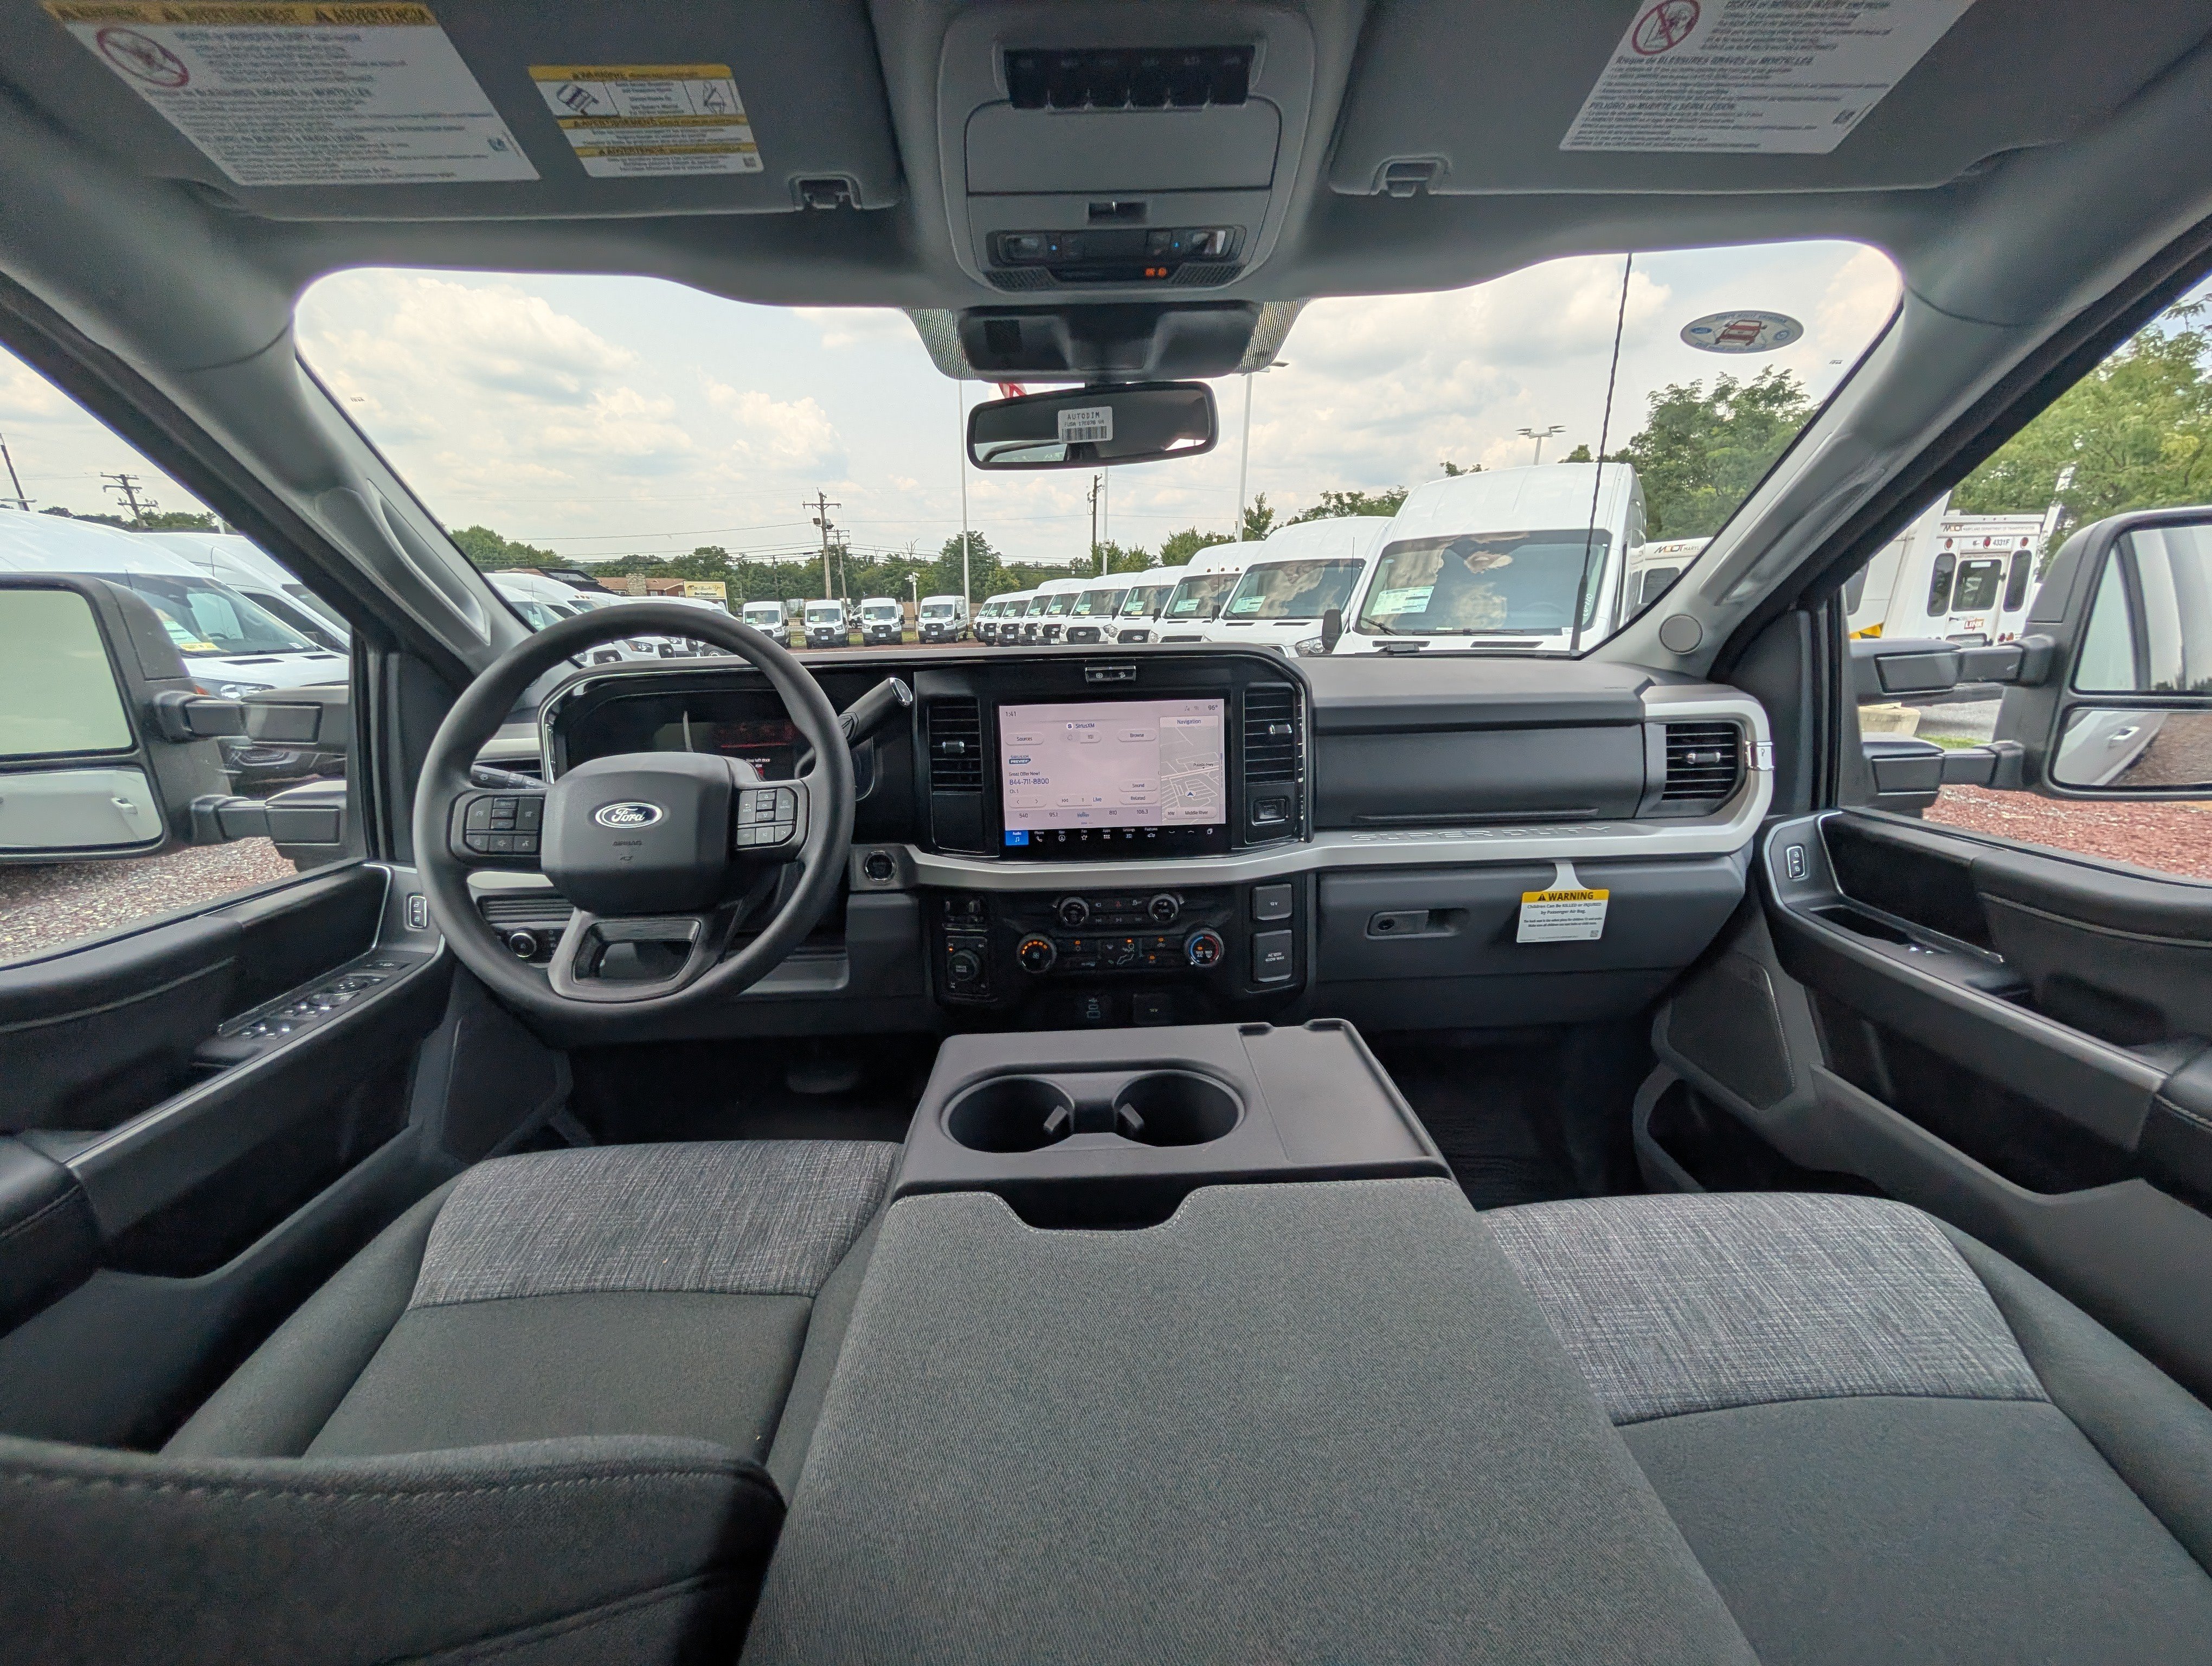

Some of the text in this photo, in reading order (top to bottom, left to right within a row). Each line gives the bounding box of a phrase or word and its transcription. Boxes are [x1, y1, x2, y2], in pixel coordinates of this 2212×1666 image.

[1067, 412, 1100, 420] AUTODIM
[611, 808, 646, 822] Ford
[1548, 892, 1593, 901] WARNING
